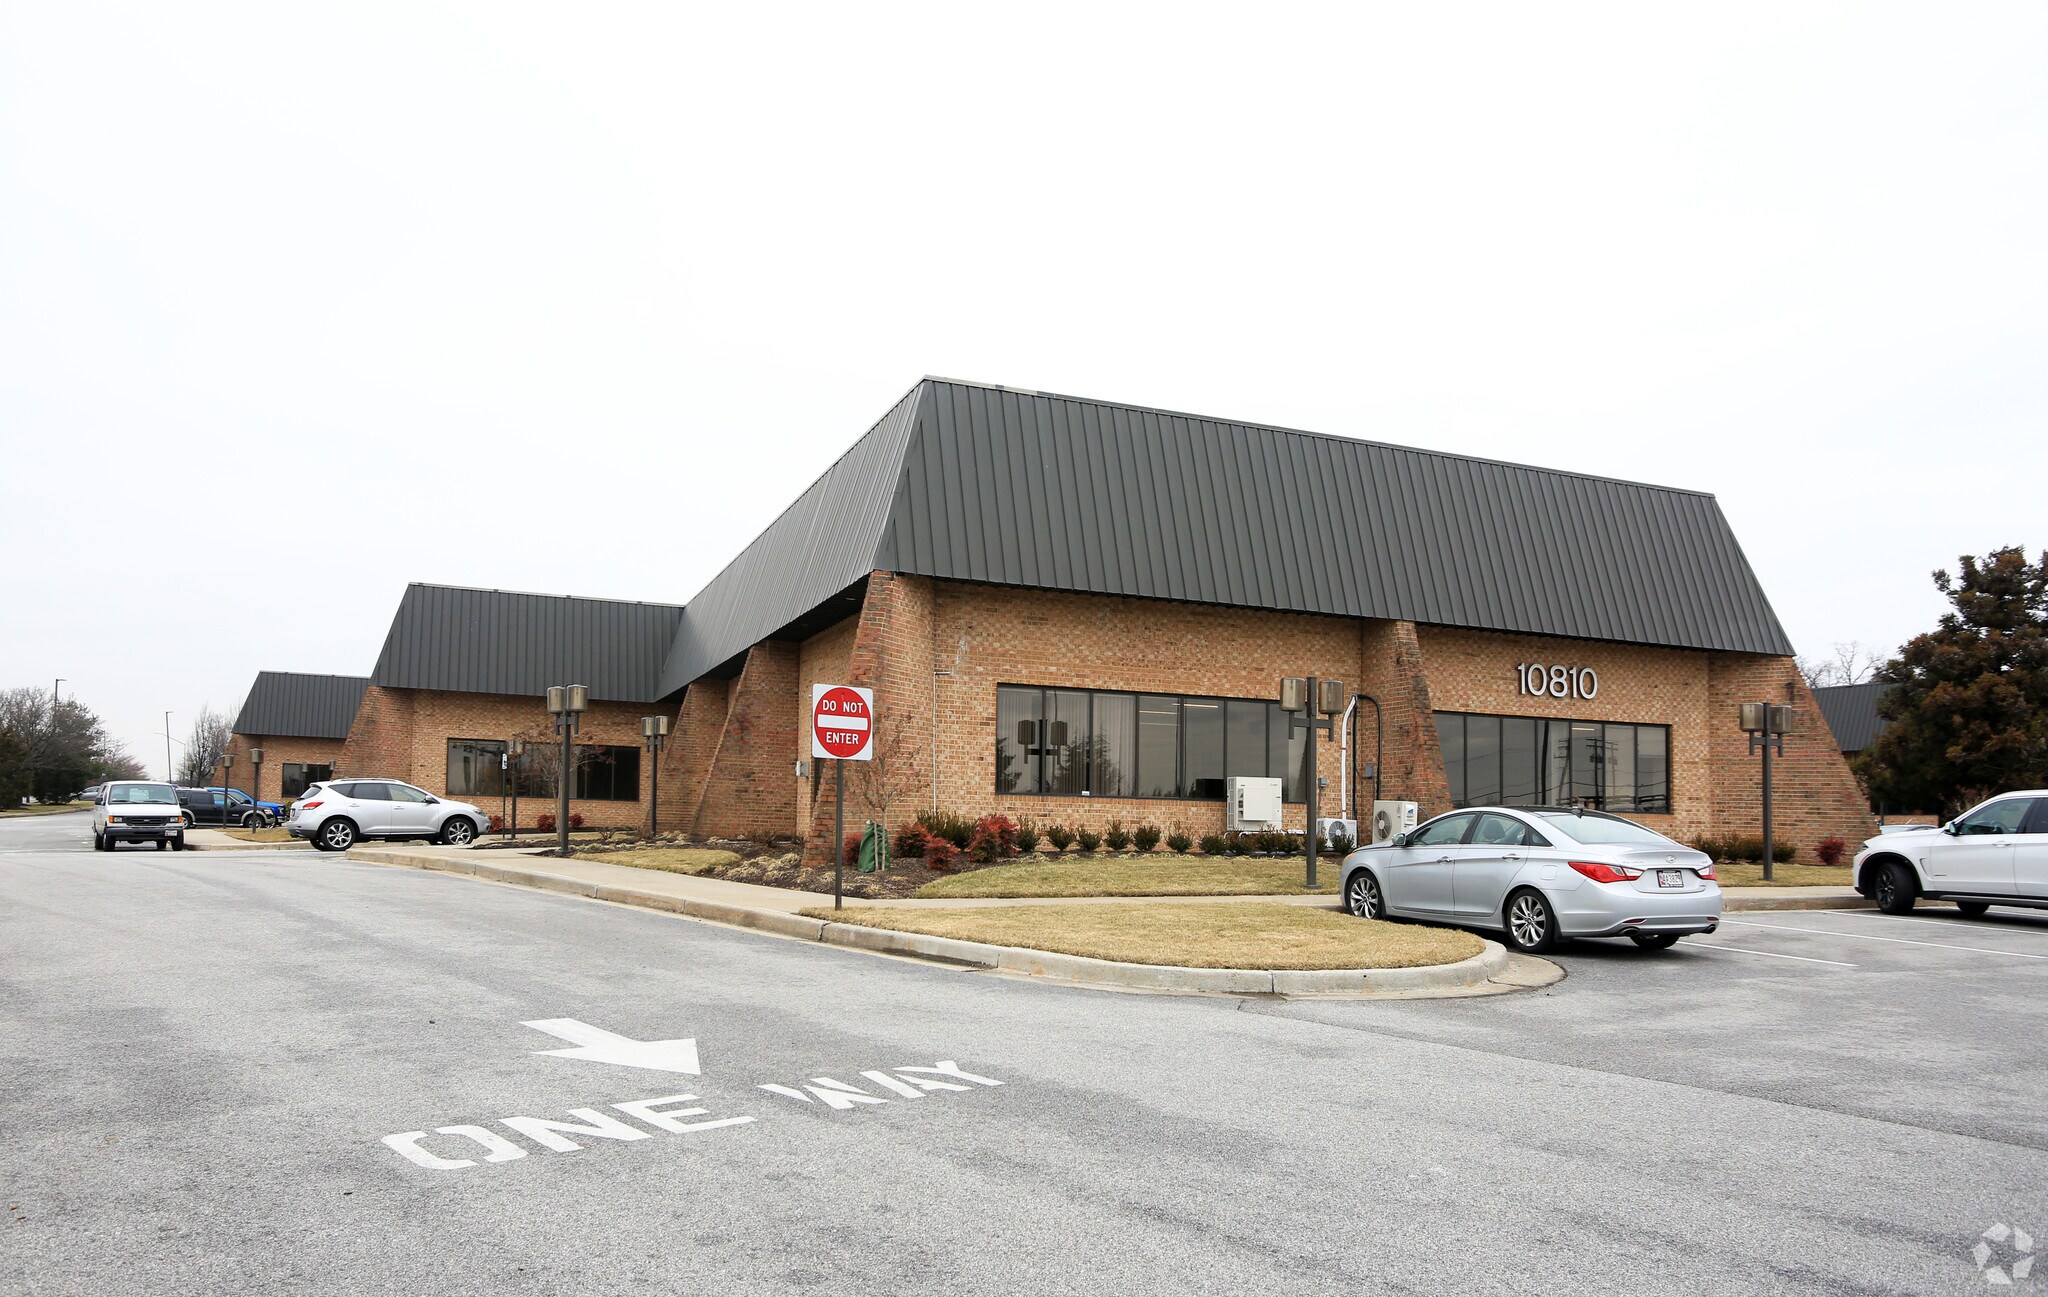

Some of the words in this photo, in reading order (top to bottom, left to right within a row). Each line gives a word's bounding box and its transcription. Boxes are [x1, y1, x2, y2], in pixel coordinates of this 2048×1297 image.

[1517, 662, 1598, 700] 10810
[822, 699, 837, 711] DO
[842, 701, 864, 714] NOT
[826, 731, 859, 745] ENTER
[380, 1093, 758, 1171] ONE
[755, 1059, 1006, 1110] WAY
